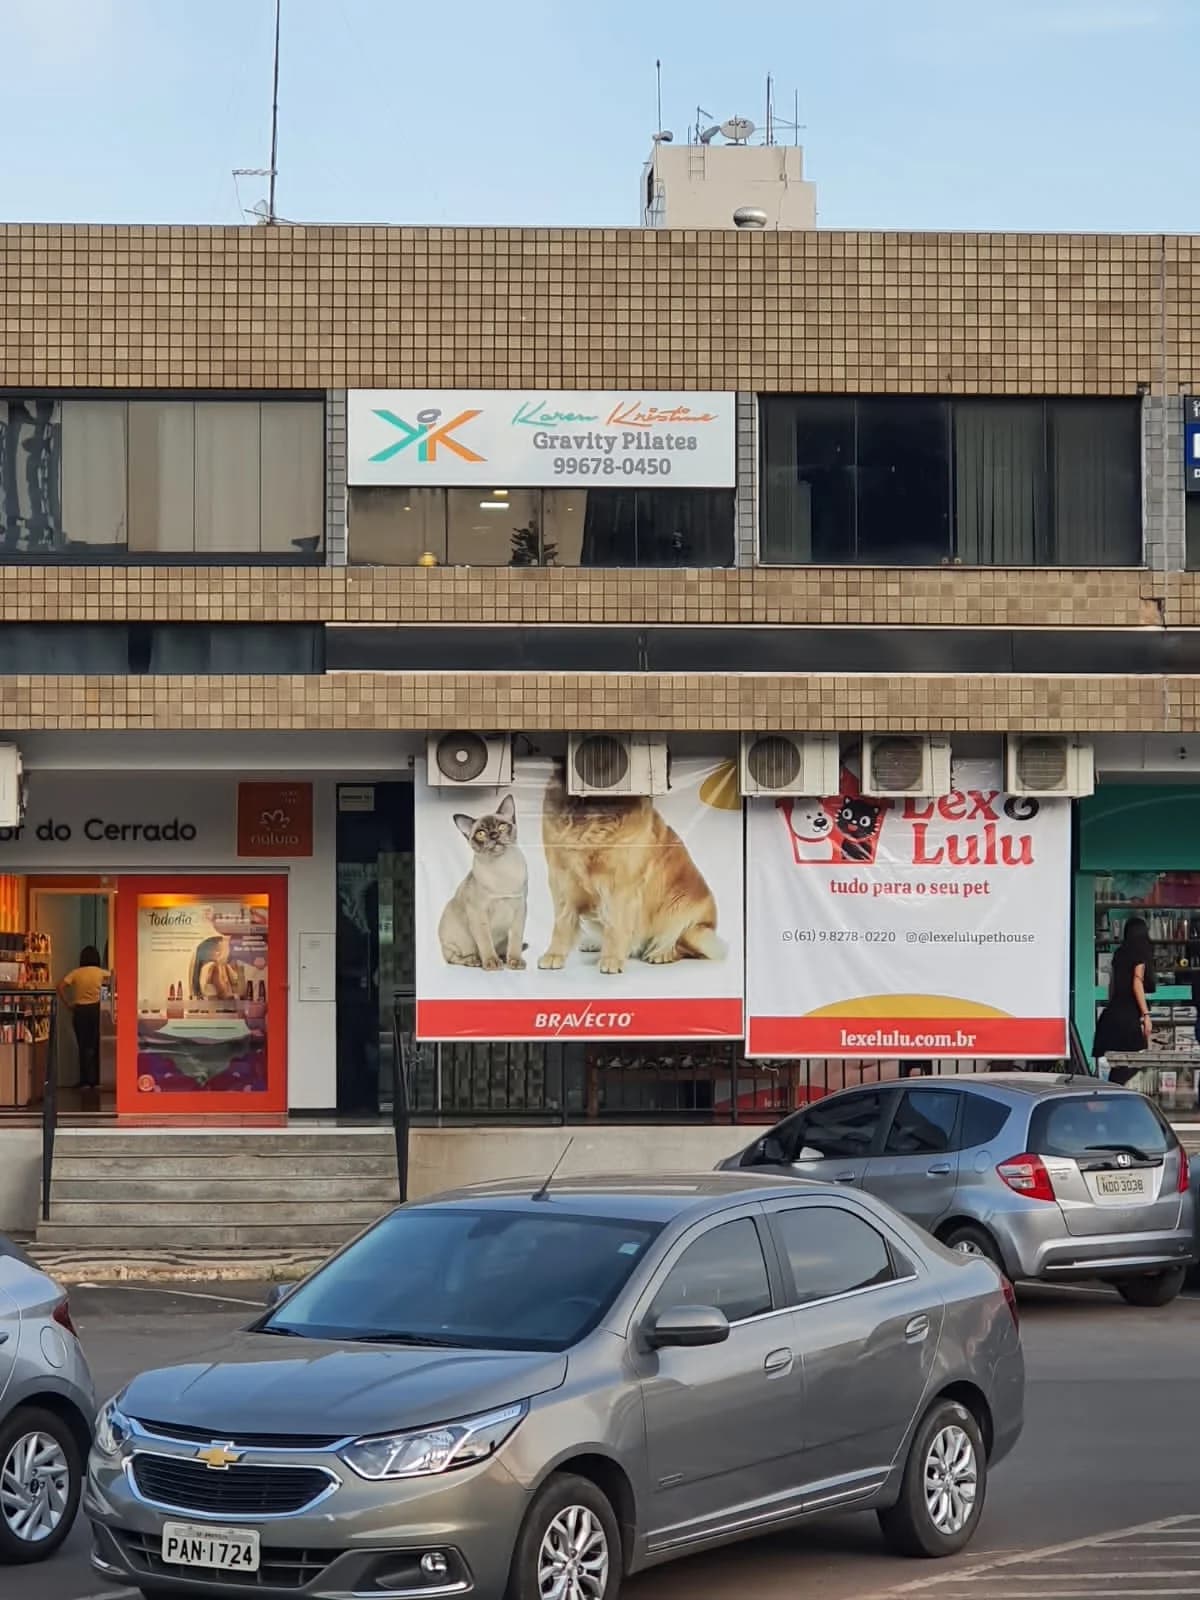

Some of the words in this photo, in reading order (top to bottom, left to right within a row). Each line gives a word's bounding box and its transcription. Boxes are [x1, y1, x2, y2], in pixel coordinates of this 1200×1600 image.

[512, 400, 598, 426] Karen
[605, 400, 719, 427] Kristine
[533, 431, 618, 454] Gravity
[622, 431, 697, 450] Pilates
[553, 457, 672, 475] 99678-0450
[36, 818, 72, 841] do
[84, 817, 197, 841] Cerrado
[911, 822, 1035, 866] Lulu
[830, 878, 868, 894] tudo
[873, 882, 911, 897] para
[916, 882, 926, 894] o
[930, 882, 959, 894] seu
[963, 879, 990, 897] pet
[794, 929, 816, 943] (61)
[818, 930, 896, 943] 9.8278-0220
[918, 930, 1035, 945] @lexelulupethouse
[840, 1029, 977, 1047] lexelulu.com.br
